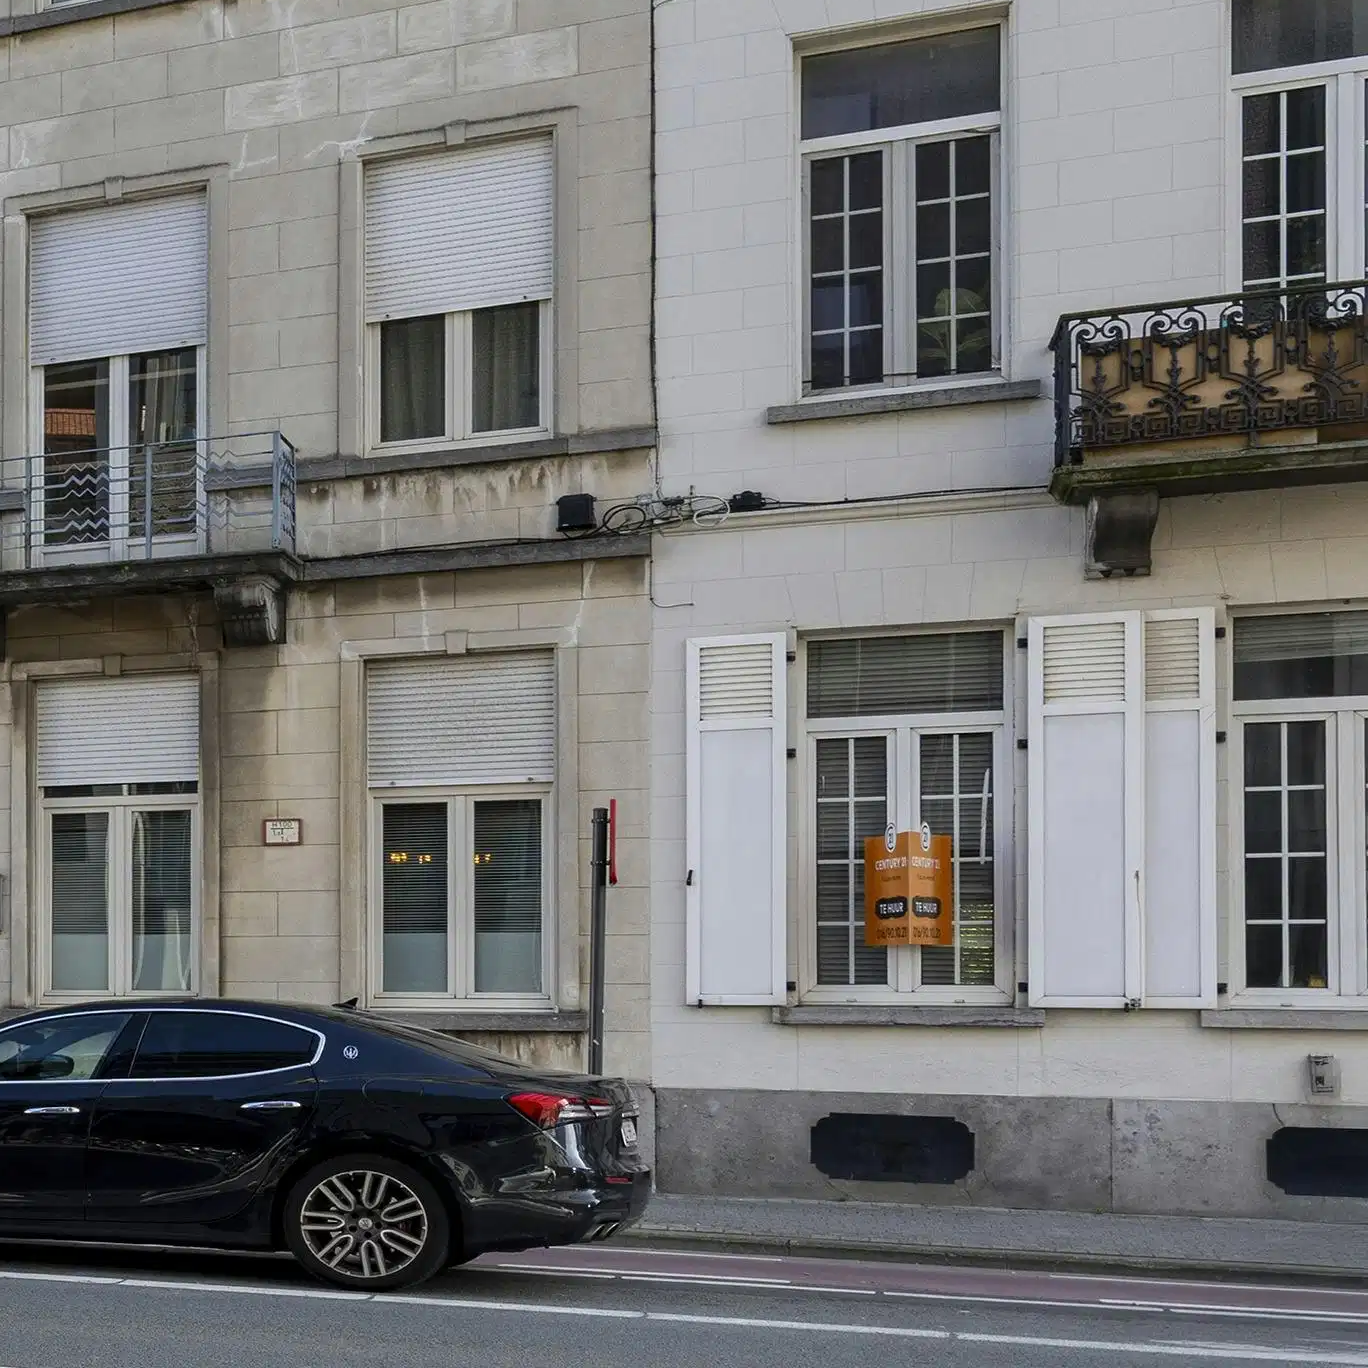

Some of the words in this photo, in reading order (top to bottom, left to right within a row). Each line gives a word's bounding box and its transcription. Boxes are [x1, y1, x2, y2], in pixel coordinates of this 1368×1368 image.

[875, 858, 901, 871] CENTURY
[912, 856, 934, 869] CENTURY
[880, 904, 887, 914] TE
[888, 902, 904, 913] HUUR
[915, 901, 922, 912] TE
[923, 903, 937, 913] HUUR
